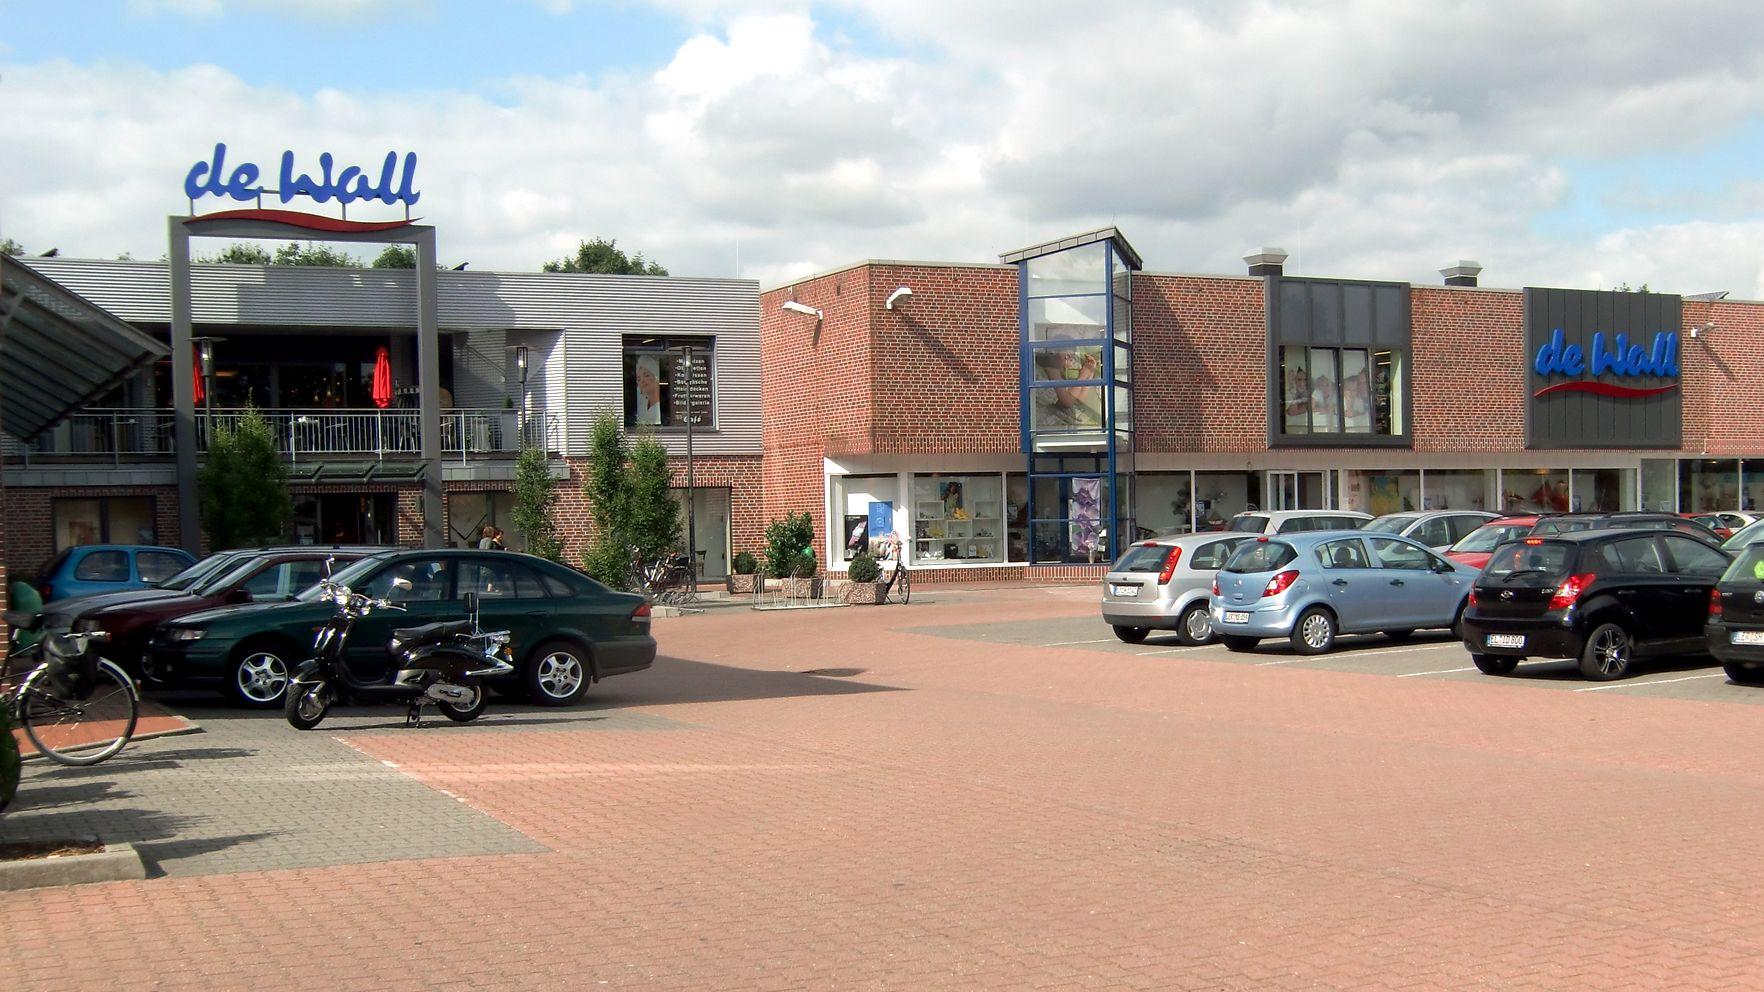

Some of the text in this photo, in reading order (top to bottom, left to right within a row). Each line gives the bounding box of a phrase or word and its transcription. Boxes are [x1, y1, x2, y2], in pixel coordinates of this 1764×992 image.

[184, 142, 421, 206] de Wall
[1535, 327, 1678, 377] de Wall
